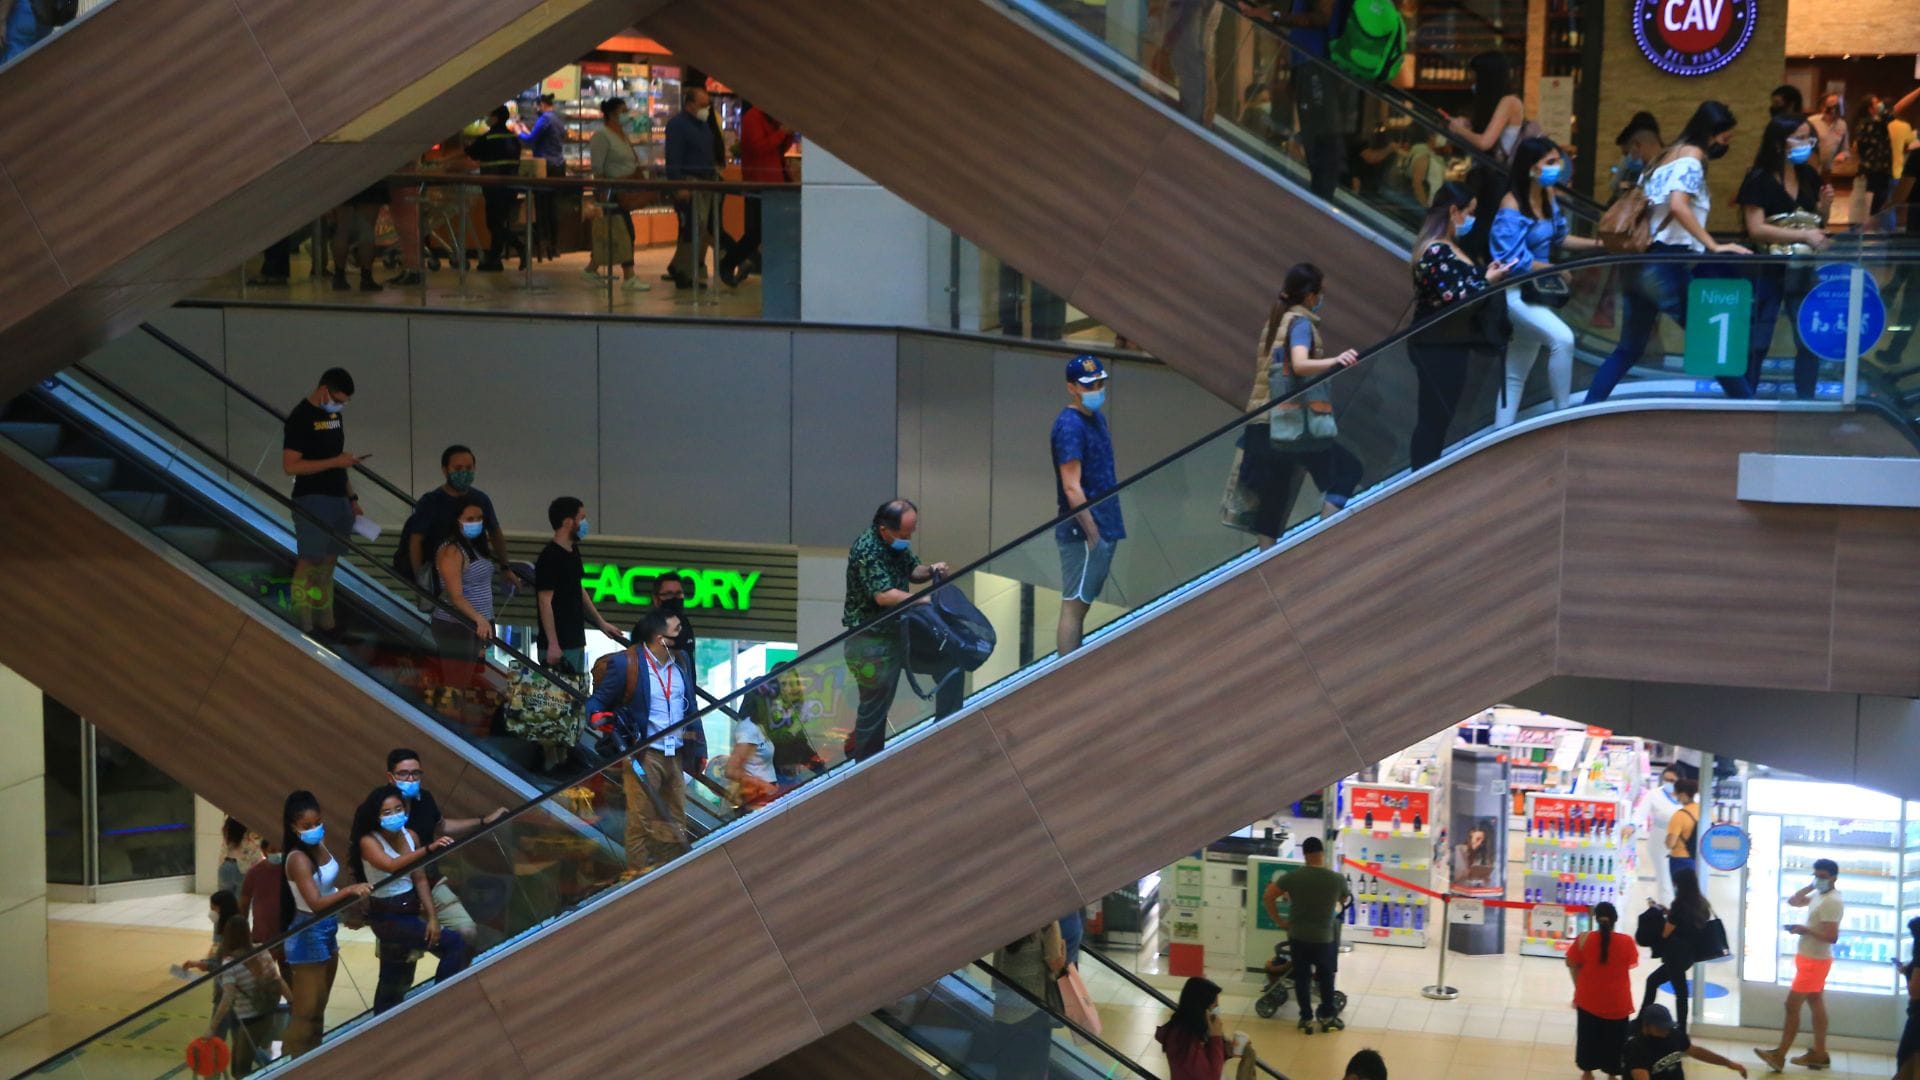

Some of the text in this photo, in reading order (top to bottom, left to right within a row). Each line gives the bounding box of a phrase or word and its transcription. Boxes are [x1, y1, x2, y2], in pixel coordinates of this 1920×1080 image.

[1664, 0, 1724, 31] CAV
[1701, 289, 1740, 304] Nivel
[1708, 312, 1730, 365] 1
